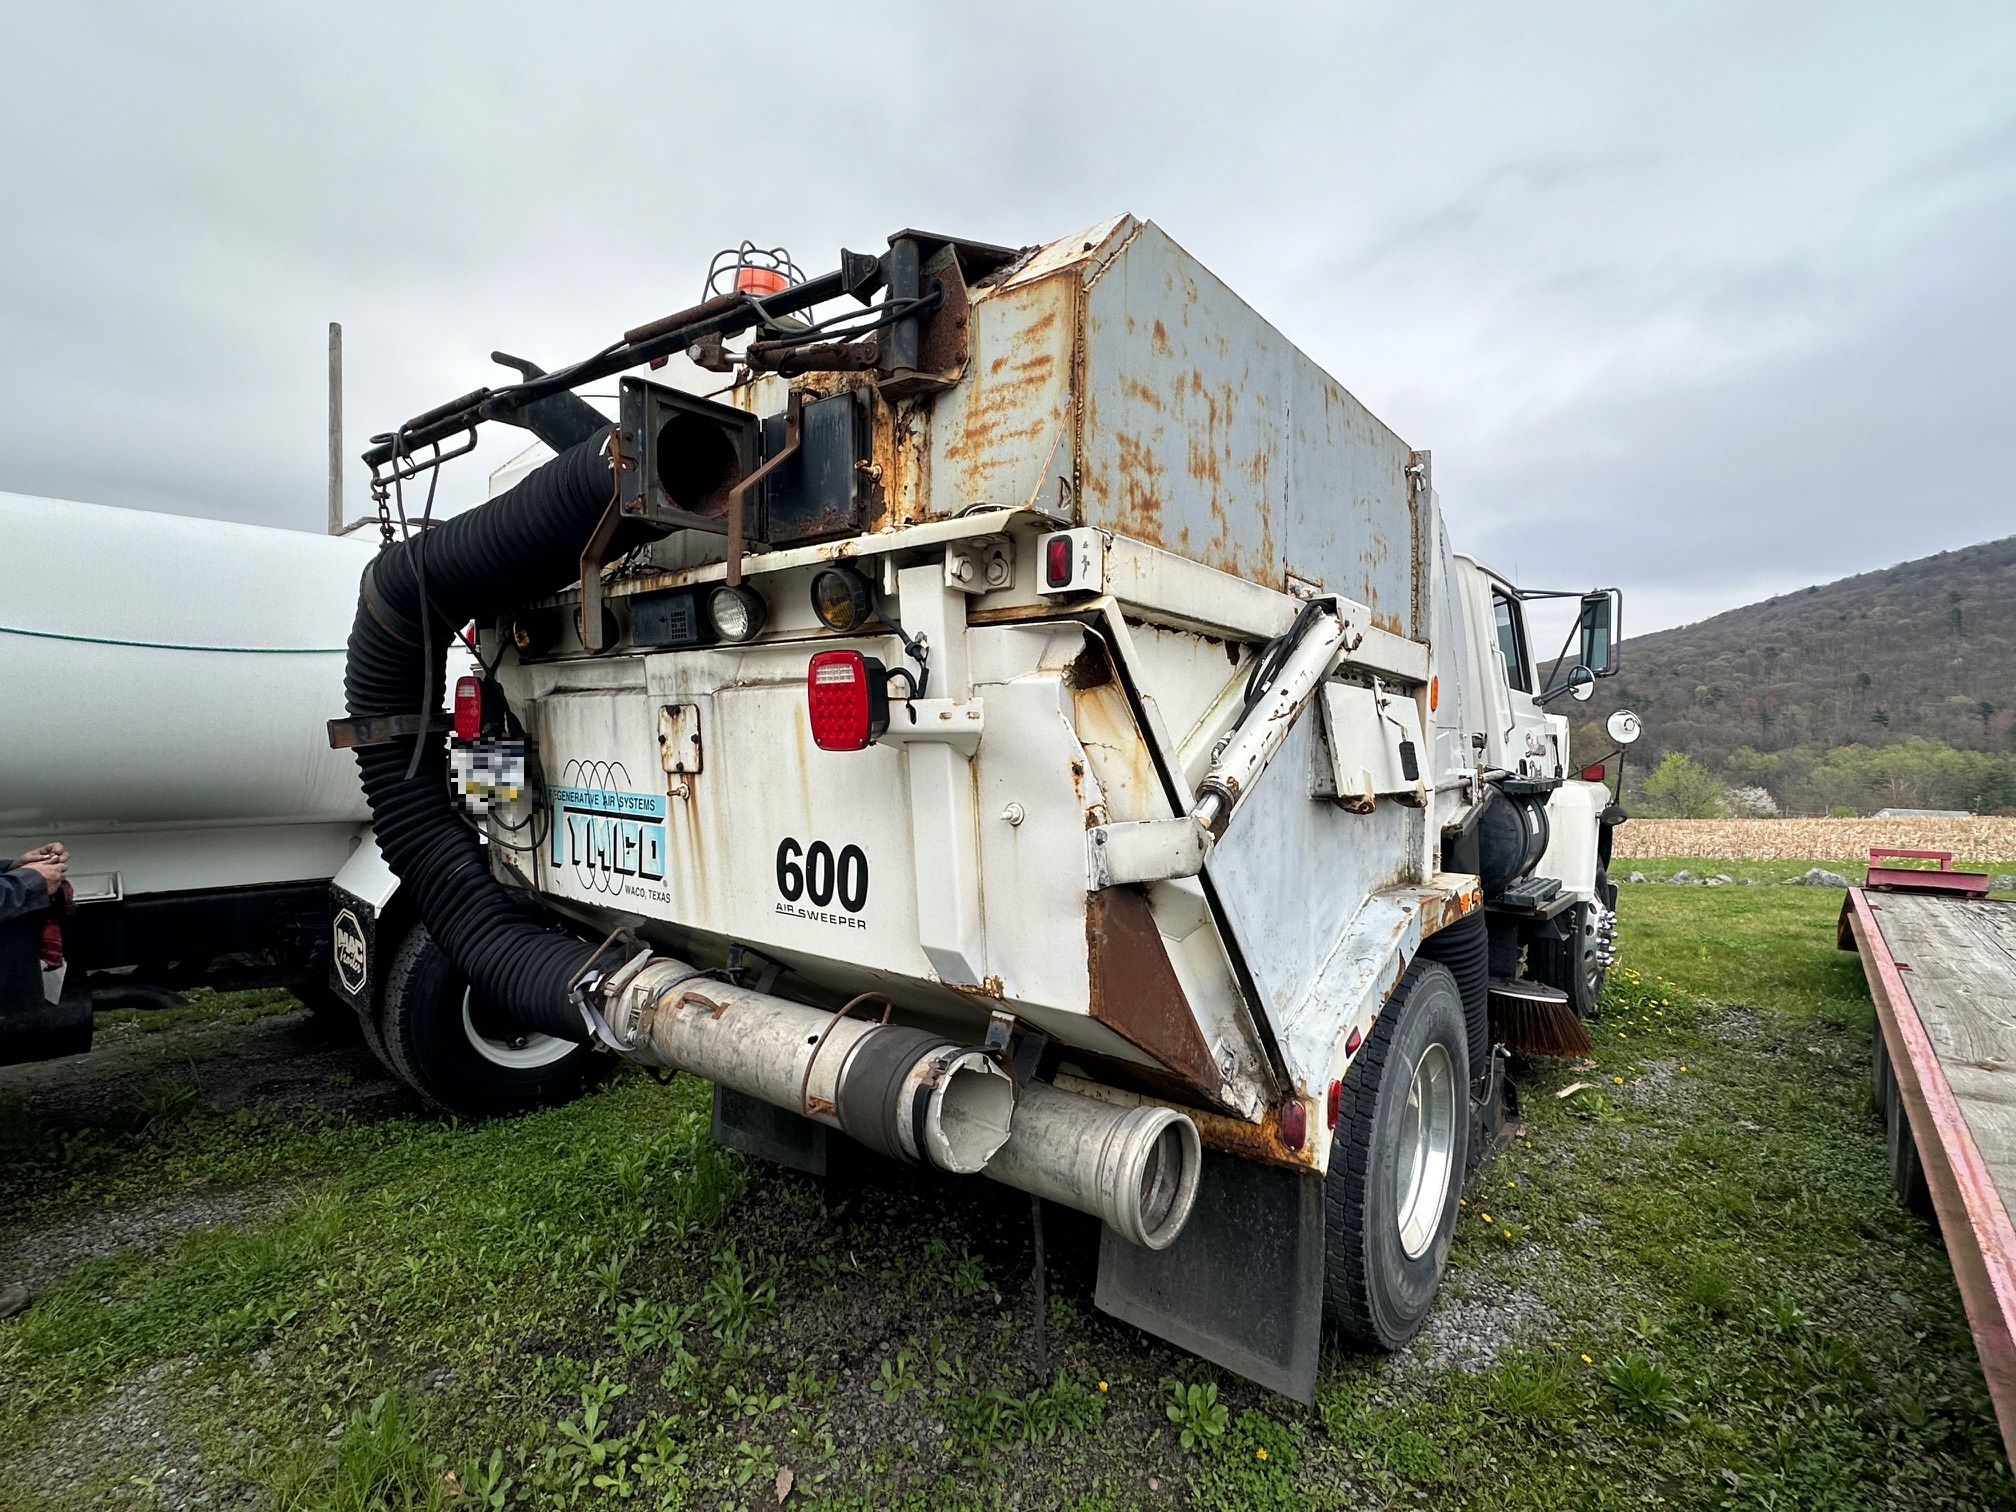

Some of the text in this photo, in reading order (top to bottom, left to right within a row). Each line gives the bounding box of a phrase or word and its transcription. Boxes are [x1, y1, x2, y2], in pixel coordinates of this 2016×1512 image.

[603, 795, 616, 807] AIR
[619, 796, 656, 811] SYSTEMS
[550, 786, 666, 881] TYMCO
[776, 836, 869, 913] 600
[625, 884, 671, 904] WACO, TEXAS
[776, 902, 867, 930] AIR SWEEPER
